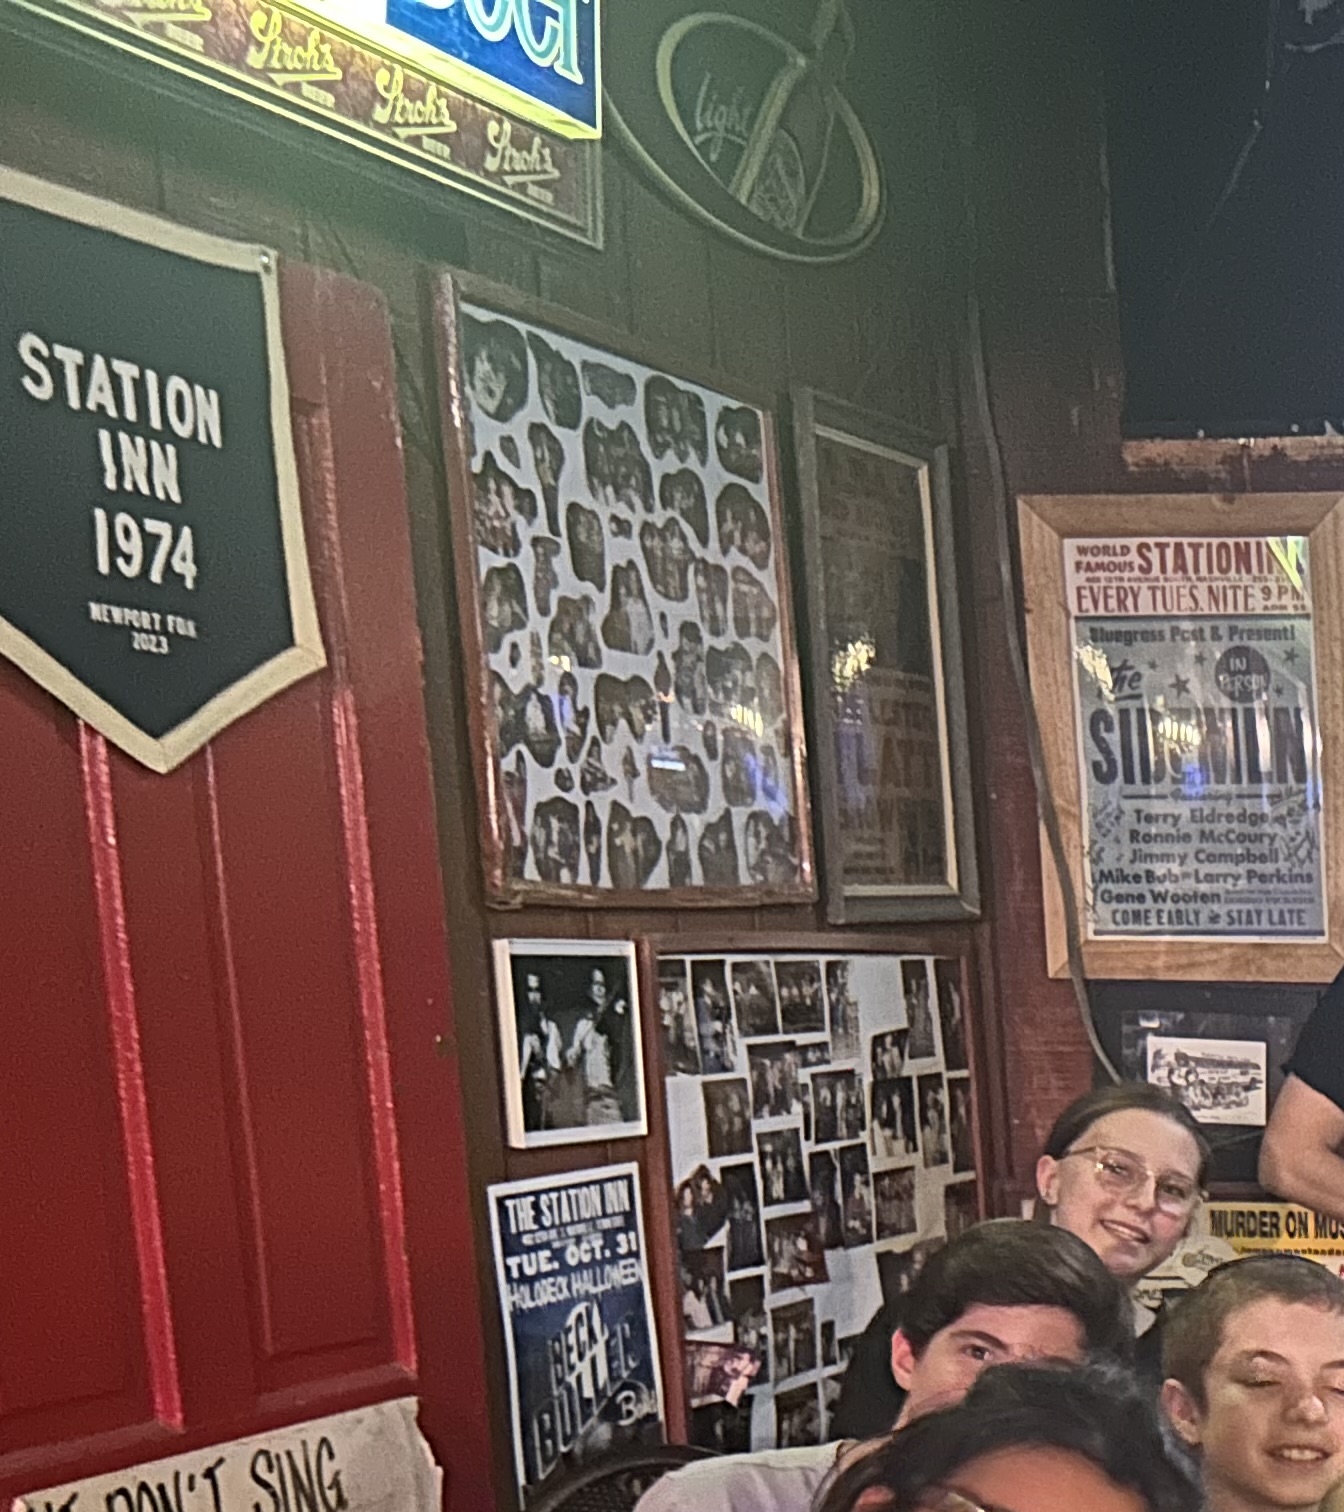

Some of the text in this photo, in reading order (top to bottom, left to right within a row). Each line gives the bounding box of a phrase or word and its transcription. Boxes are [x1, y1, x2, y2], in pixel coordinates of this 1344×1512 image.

[17, 331, 222, 448] STATION
[98, 428, 182, 503] INN
[94, 507, 198, 590] 1974
[1076, 544, 1131, 558] WORLD
[1136, 541, 1254, 575] STATION
[1074, 560, 1135, 574] FAMOUS
[1076, 585, 1141, 613] EVERY
[1208, 584, 1256, 612] NITE
[1261, 586, 1273, 601] 9
[88, 601, 162, 632] NEWPORT
[131, 631, 168, 654] 2023
[1089, 626, 1165, 646] Bluegrass
[1210, 626, 1223, 642] &
[1229, 656, 1248, 671] IN
[1134, 807, 1269, 827] Terry Eldredge
[1129, 829, 1278, 848] Ronnie McCoury
[1129, 848, 1279, 867] Jimmy Campbell
[1099, 869, 1142, 884] Mike
[1247, 869, 1313, 884] Perkins
[1100, 889, 1146, 904] Gene
[1150, 889, 1221, 904] Wooten
[1111, 909, 1307, 926] COME EARLY STAY LATE
[504, 1196, 539, 1235] THE
[539, 1184, 603, 1228] STATION
[603, 1179, 631, 1215] INN
[1210, 1210, 1308, 1239] MURDER ON
[505, 1250, 560, 1279] TUE.
[565, 1239, 611, 1267] OCT.
[616, 1231, 637, 1255] 31
